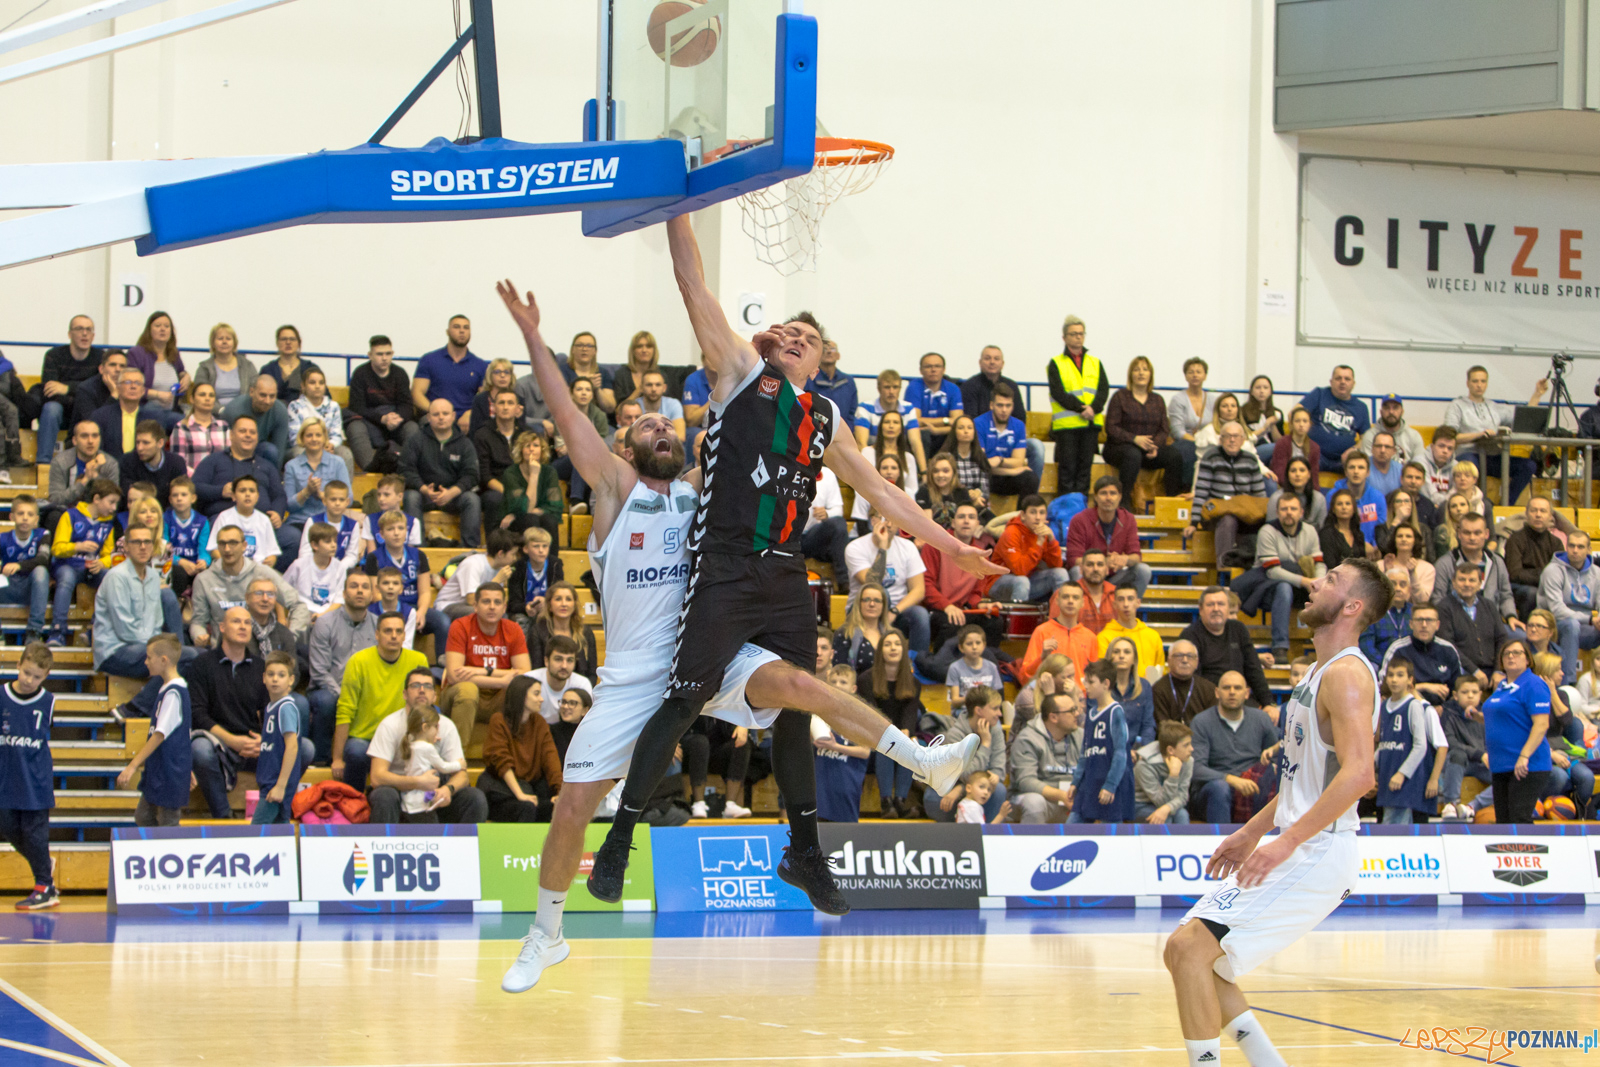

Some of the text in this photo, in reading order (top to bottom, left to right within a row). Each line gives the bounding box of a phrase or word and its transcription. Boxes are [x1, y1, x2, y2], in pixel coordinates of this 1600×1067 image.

[391, 156, 620, 195] SPORT SYSTEM
[122, 284, 144, 307] D
[1427, 277, 1476, 292] WIĘCEJ
[1484, 280, 1506, 293] NIŻ
[1514, 282, 1549, 296] KLUB
[742, 303, 762, 326] C
[809, 431, 825, 459] 5
[664, 527, 681, 554] 9
[626, 564, 689, 583] BIOFAR
[33, 709, 42, 730] 7
[266, 715, 275, 734] 6
[1393, 714, 1403, 731] 9
[1094, 721, 1106, 739] 12
[371, 841, 439, 852] fundacja
[124, 853, 281, 880] BIOFARM
[828, 841, 981, 876] drukma
[1040, 856, 1087, 874] atrem
[1156, 854, 1224, 881] POZ
[1359, 853, 1440, 871] unclub
[1496, 856, 1542, 869] JOKER
[373, 853, 441, 892] PBG
[1386, 871, 1440, 880] podróży
[237, 881, 269, 889] LEKÓW
[703, 877, 774, 898] HOTEL
[834, 876, 982, 890] DRUKARNIA SKOCZYŃSKI
[706, 898, 776, 908] POZNAŃSKI
